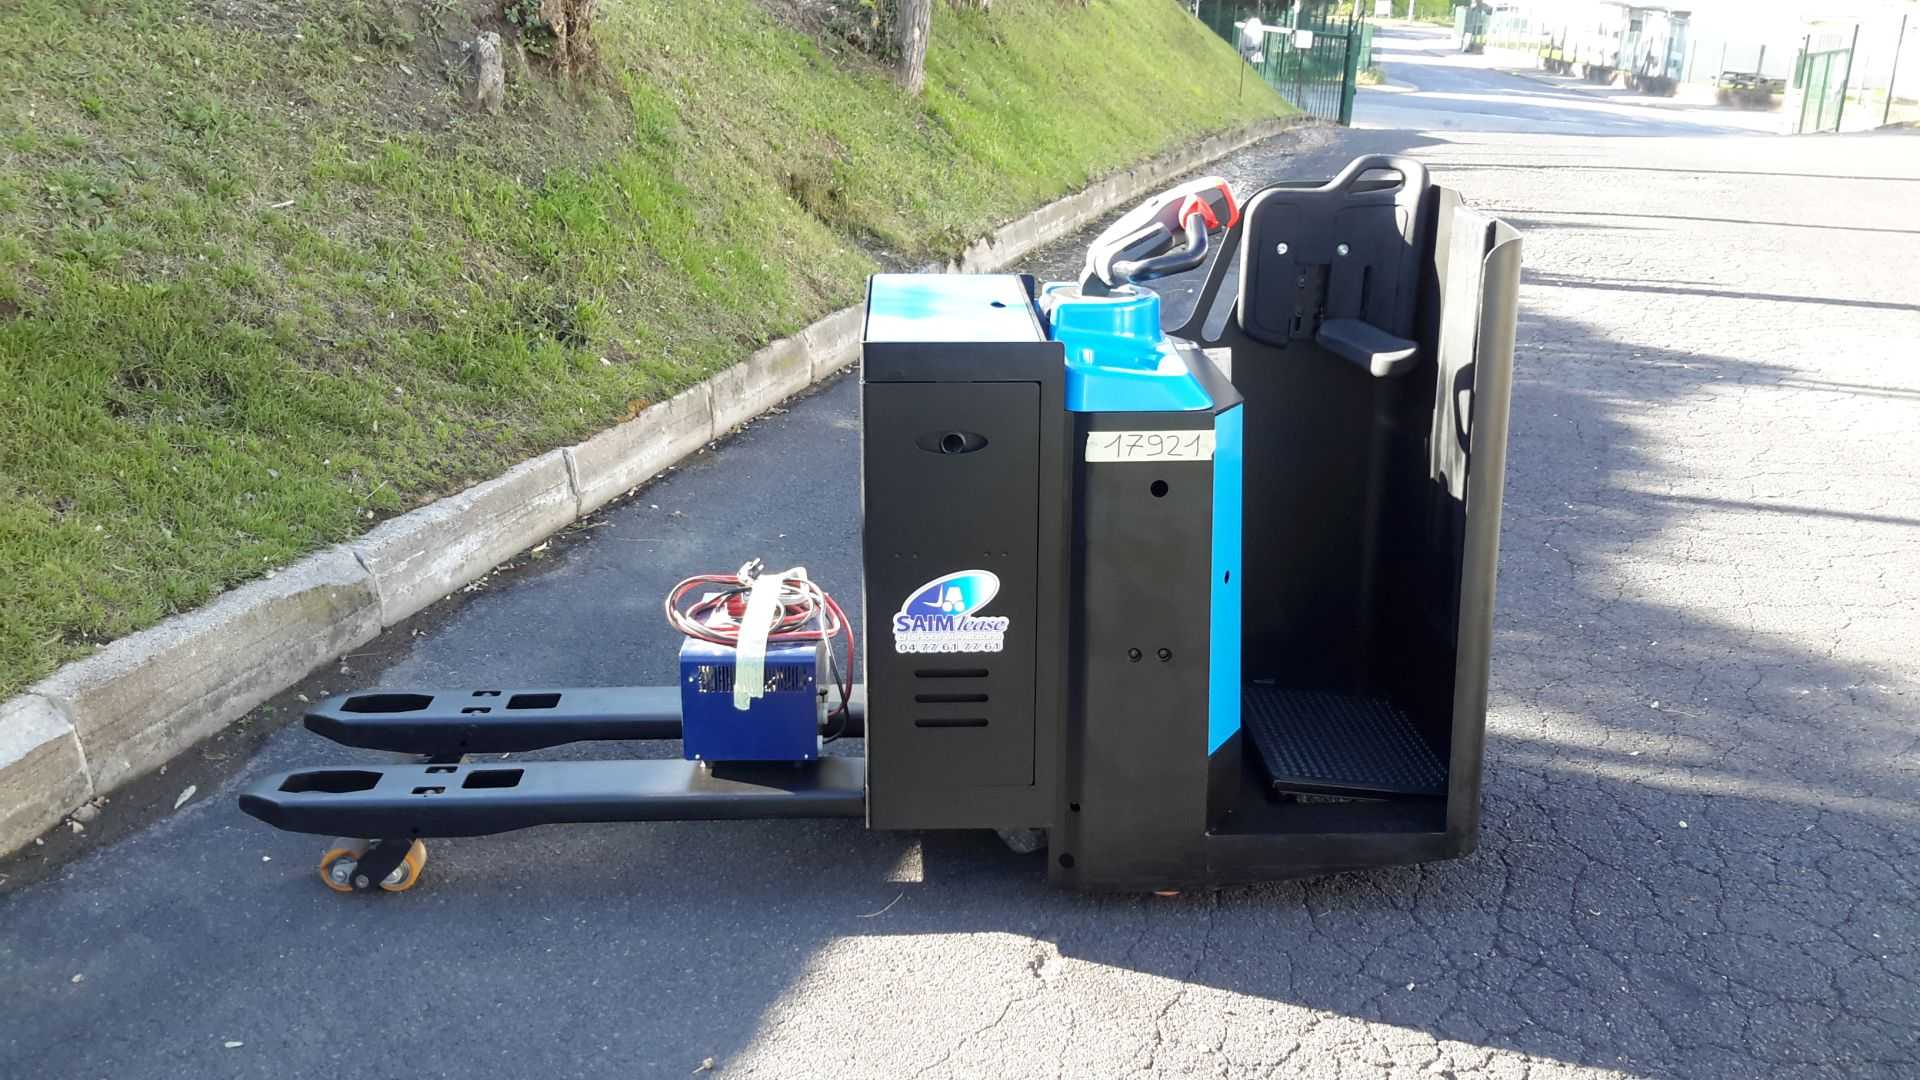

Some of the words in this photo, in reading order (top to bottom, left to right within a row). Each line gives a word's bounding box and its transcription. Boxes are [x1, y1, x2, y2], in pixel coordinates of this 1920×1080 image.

[1104, 433, 1201, 458] 17921
[896, 615, 954, 632] SAIM
[957, 616, 1006, 632] lease
[899, 643, 916, 652] 04
[942, 643, 957, 652] 61
[984, 643, 1000, 652] 61
